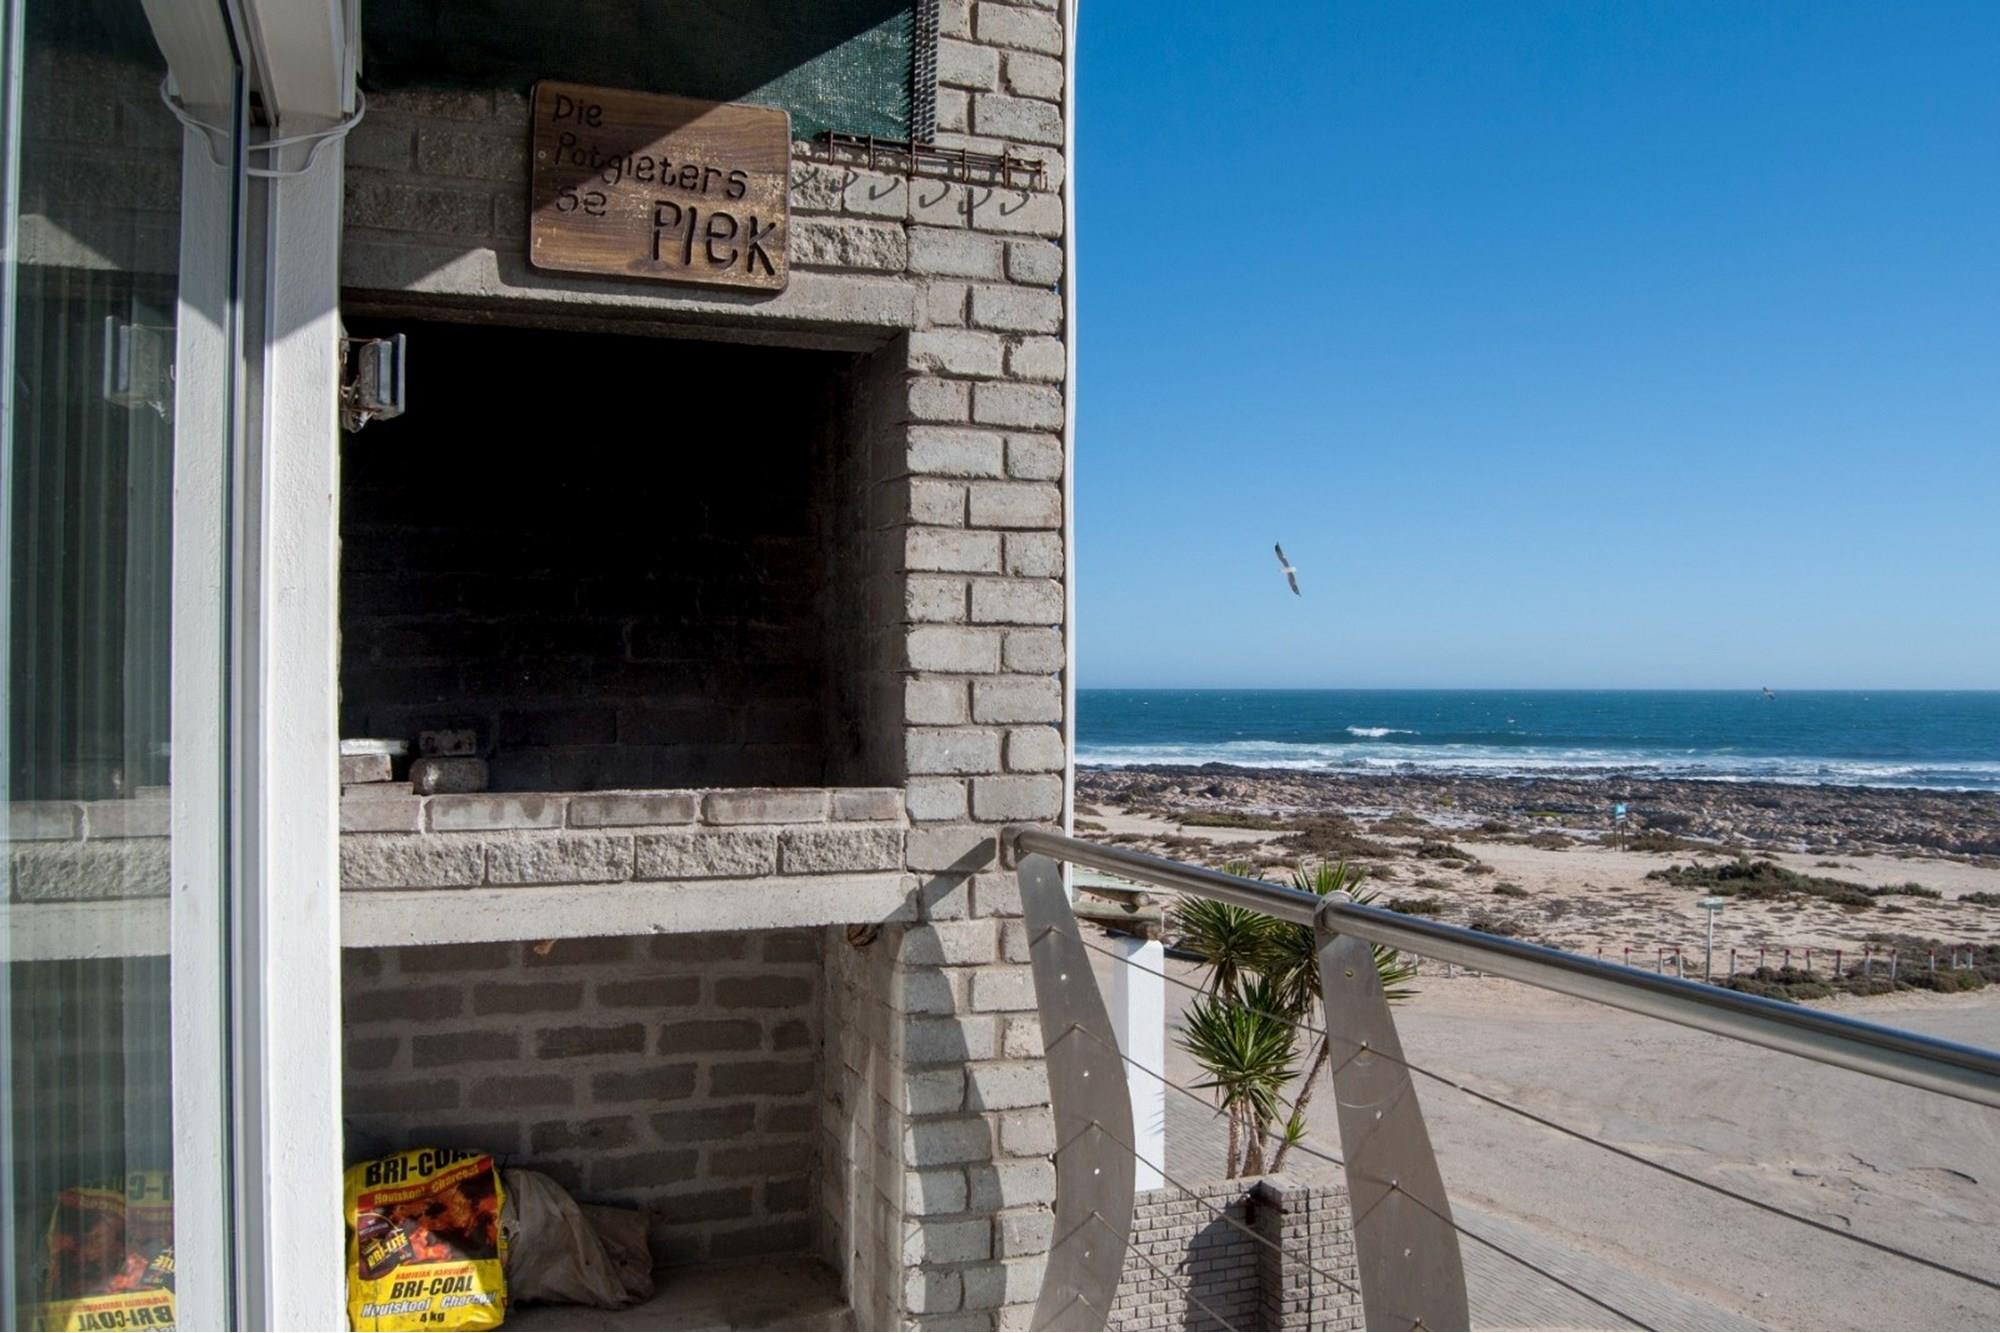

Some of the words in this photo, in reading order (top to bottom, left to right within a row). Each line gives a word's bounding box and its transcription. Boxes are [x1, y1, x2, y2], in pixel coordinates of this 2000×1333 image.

[552, 93, 603, 128] Die
[554, 132, 748, 199] Potgieters
[365, 1150, 480, 1188] BRI-COA
[431, 1164, 480, 1192] Charcoal
[390, 1275, 473, 1299] BRI-COAL
[361, 1298, 432, 1318] Houtskool
[430, 1311, 446, 1323] kg
